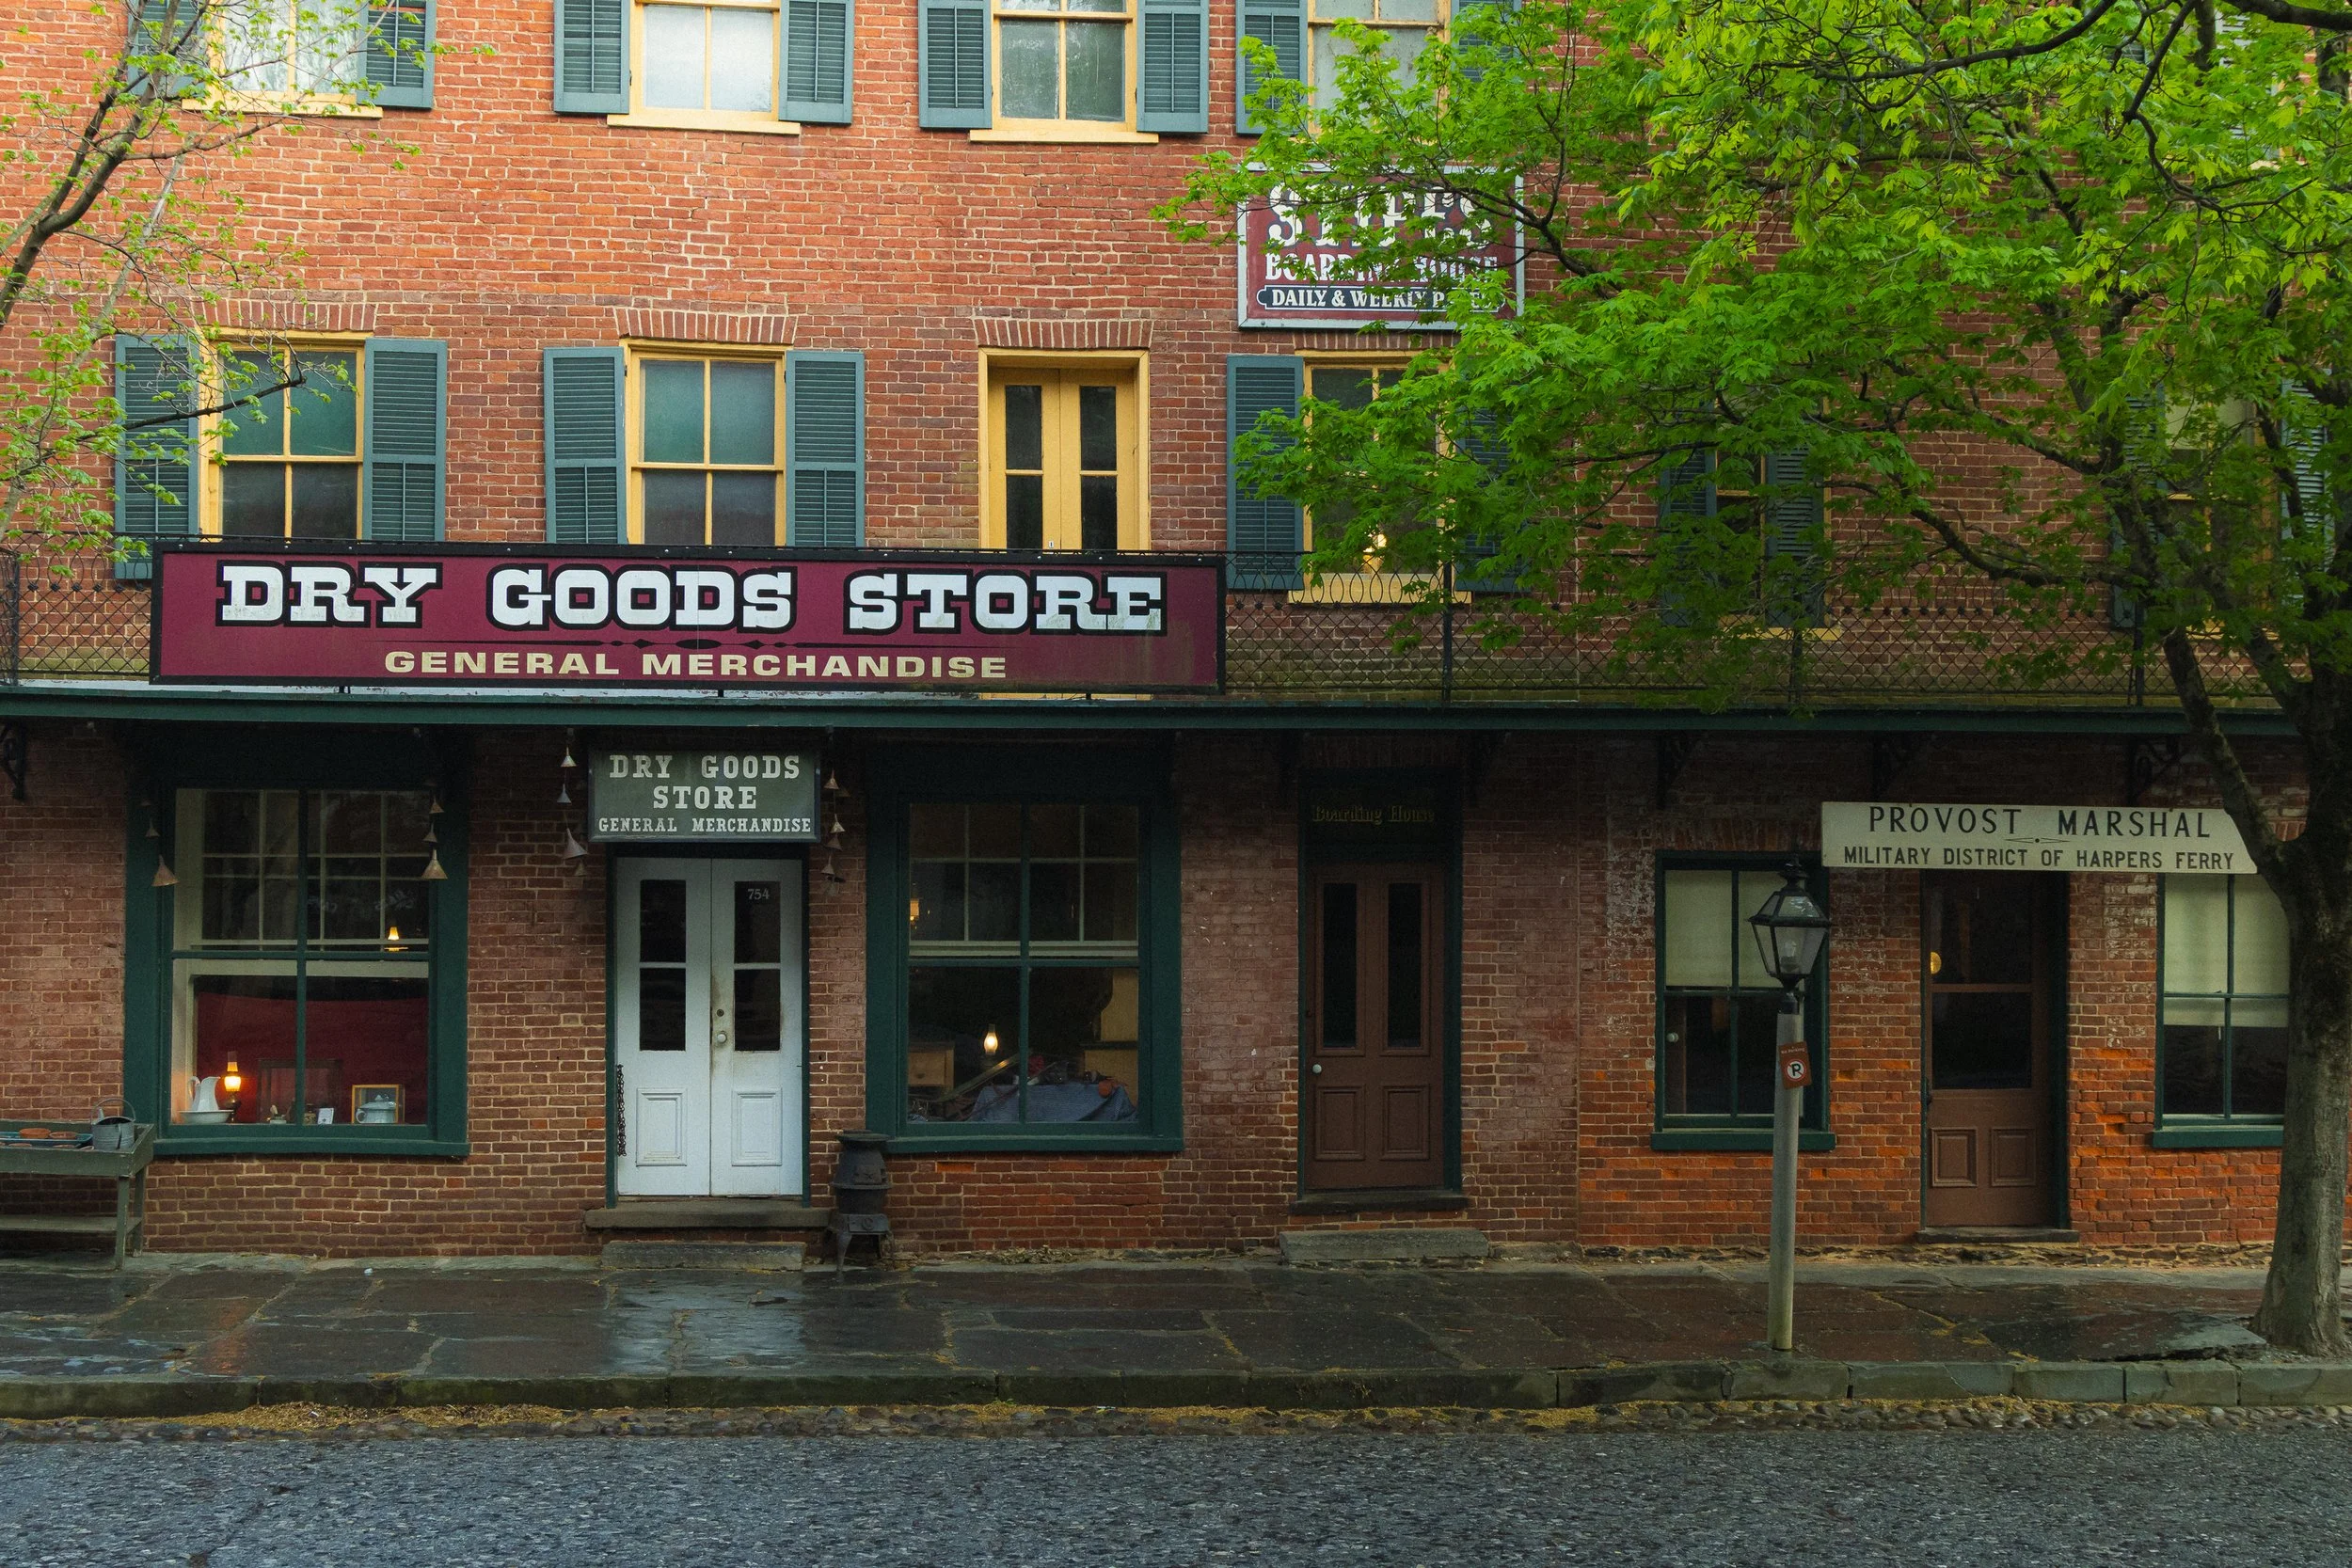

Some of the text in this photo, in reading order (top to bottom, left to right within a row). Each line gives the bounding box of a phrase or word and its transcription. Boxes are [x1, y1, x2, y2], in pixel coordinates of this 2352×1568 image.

[1272, 289, 1327, 307] DAILY
[1331, 290, 1346, 307] &
[1349, 290, 1427, 309] WEEKLY
[221, 564, 1163, 631] DRY GOODS STORE
[385, 651, 1007, 679] GENERAL MERCHANDISE
[609, 755, 800, 779] DRY GOODS
[653, 786, 756, 810] STORE
[598, 817, 811, 833] GENERAL MERCHANDISE
[1312, 805, 1435, 826] Boarding House
[1869, 806, 2211, 838] PROVOST MARSHAL
[1844, 847, 2234, 870] MILITARY DISTRICT OF HARPERS FERRY
[747, 888, 771, 900] 754
